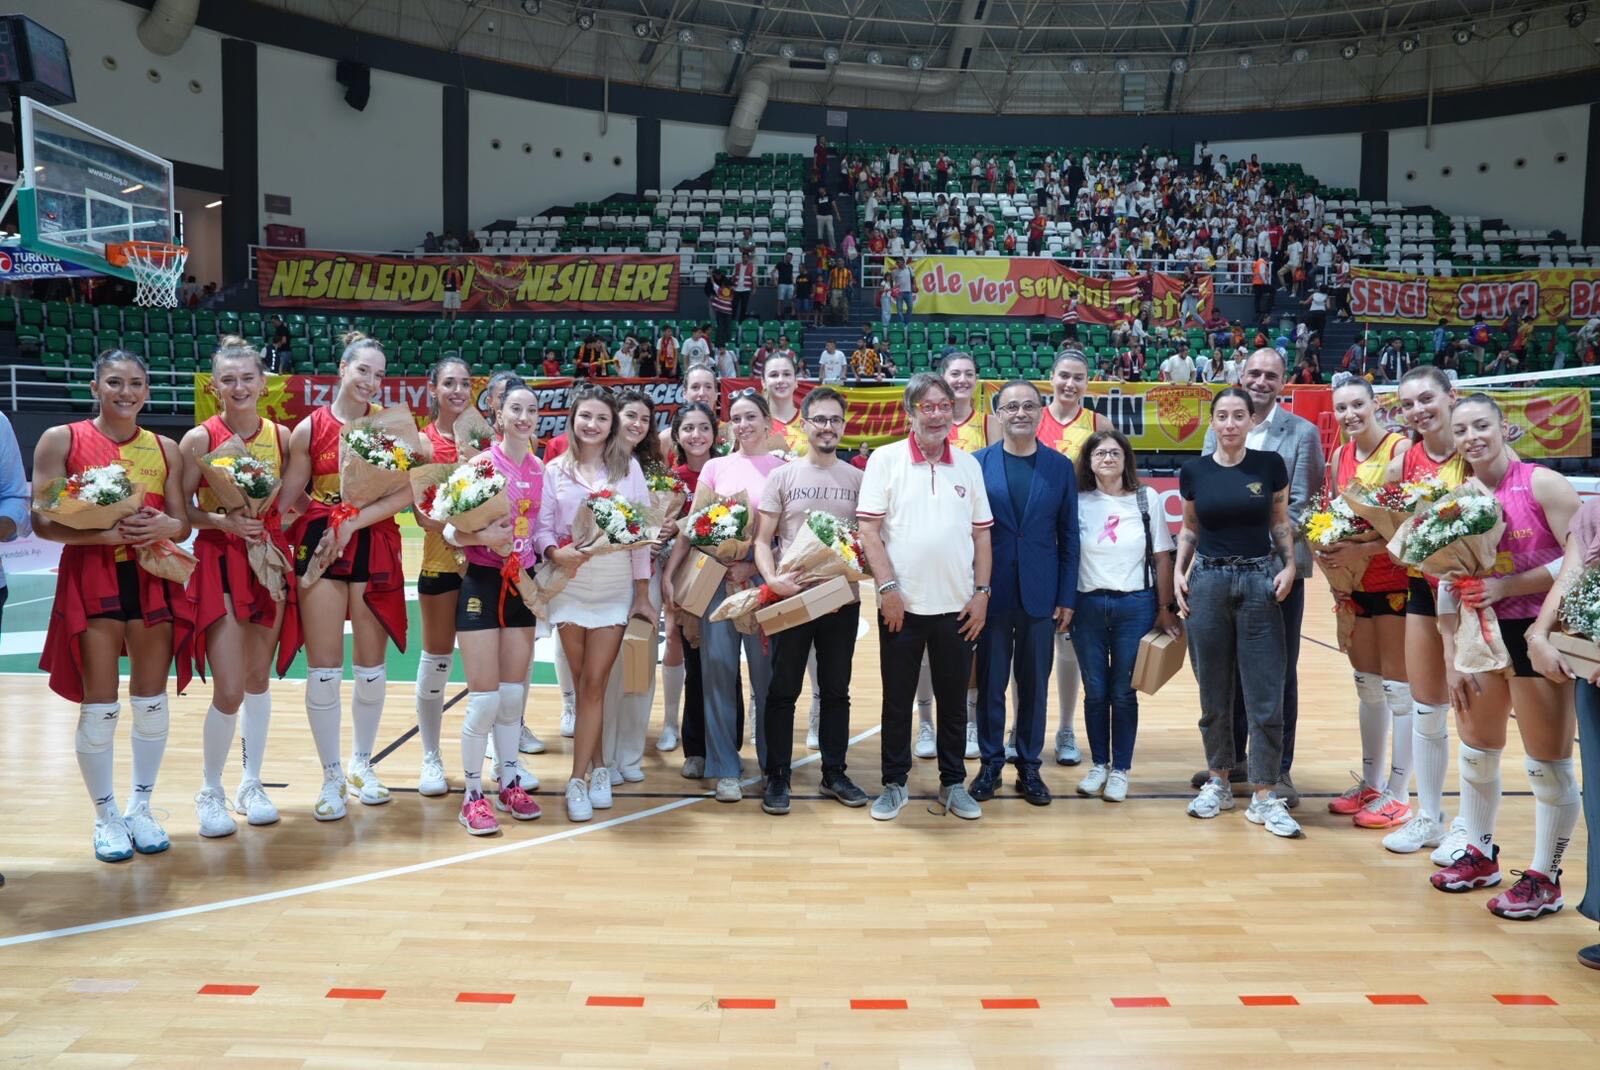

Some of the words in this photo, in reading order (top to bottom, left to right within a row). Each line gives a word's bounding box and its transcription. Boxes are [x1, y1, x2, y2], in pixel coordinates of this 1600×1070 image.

[516, 258, 674, 302] NESİLLERE
[921, 263, 963, 295] ele
[1350, 277, 1429, 317] SEVGİ
[1458, 282, 1538, 319] SAYGI
[785, 486, 860, 502] ABSOLUTELY
